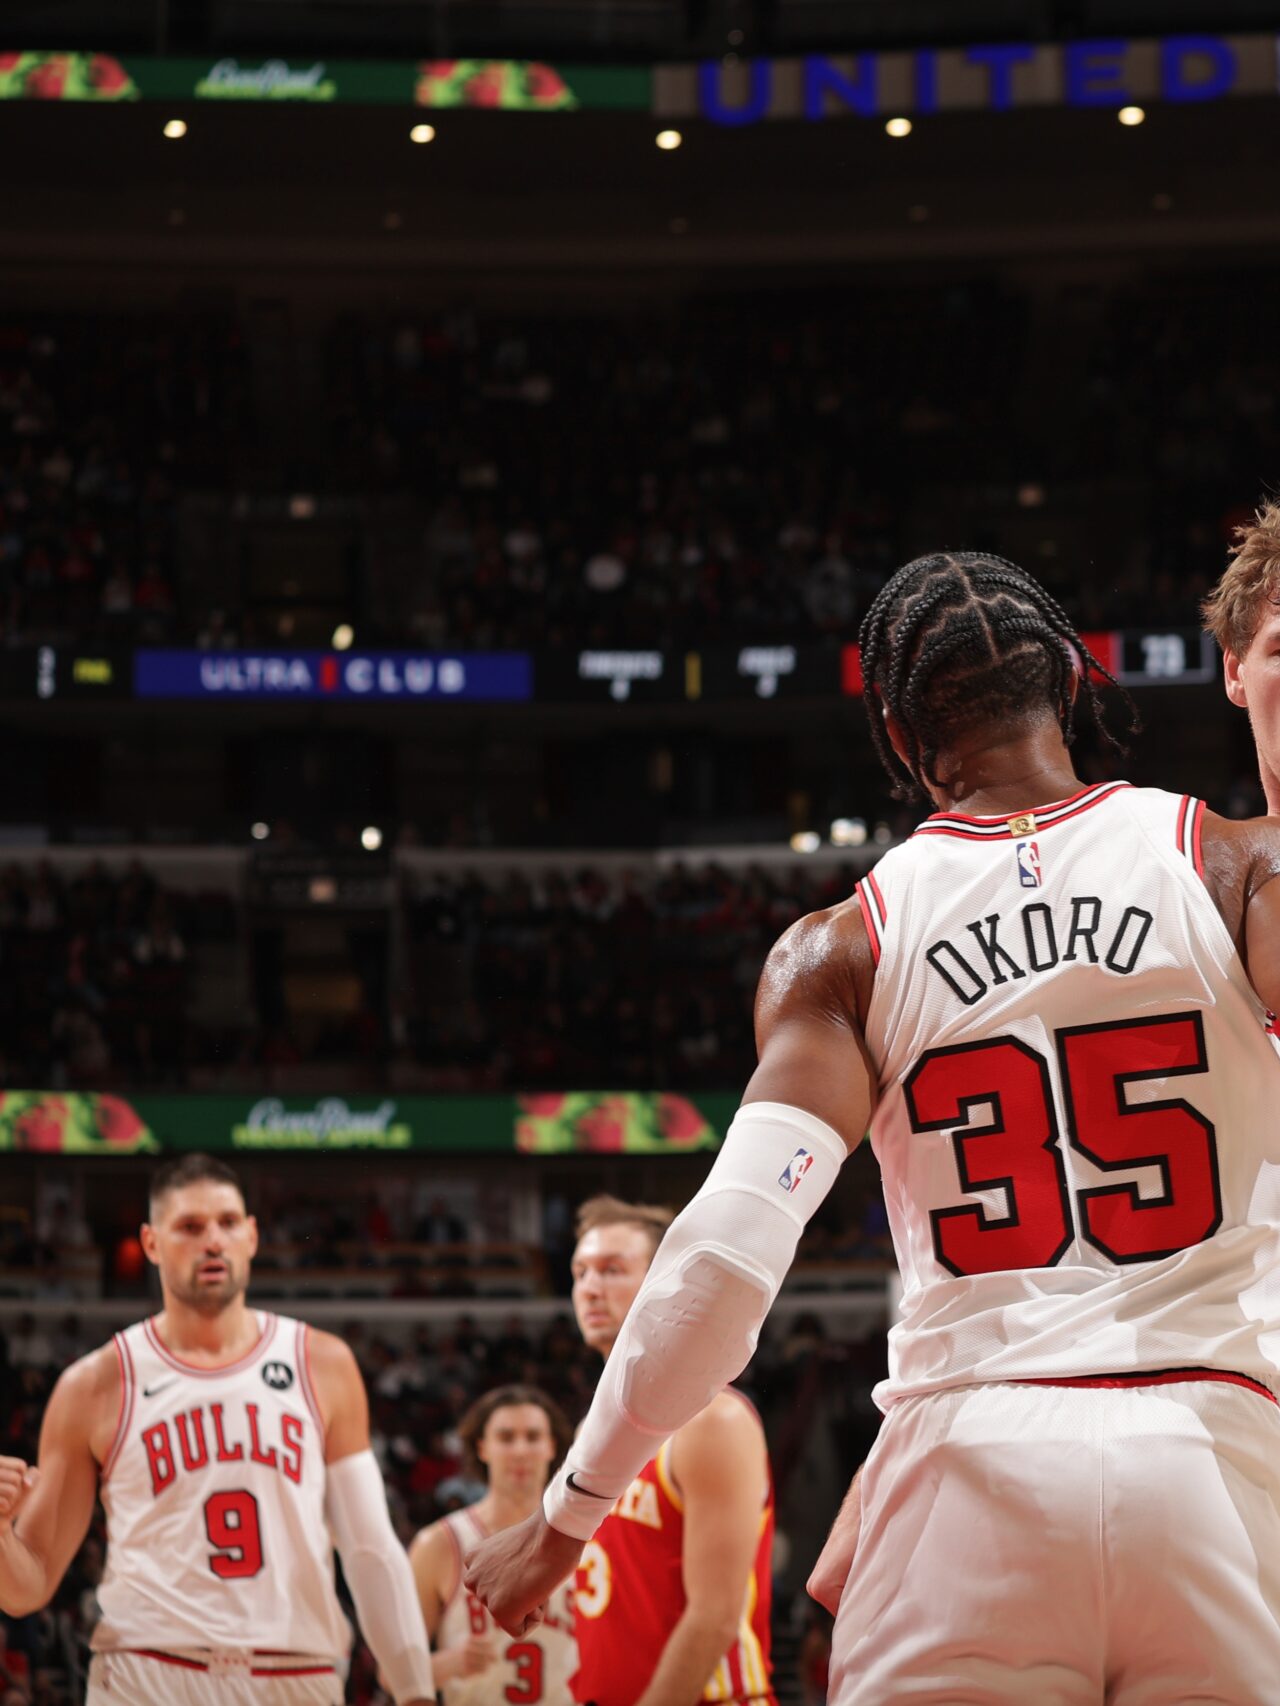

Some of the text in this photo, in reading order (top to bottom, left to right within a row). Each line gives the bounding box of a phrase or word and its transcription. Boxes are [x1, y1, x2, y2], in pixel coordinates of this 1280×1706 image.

[697, 33, 1237, 125] UNITED
[200, 656, 465, 694] ULTRA CLUB
[927, 896, 1153, 1005] OKORO
[903, 1010, 1222, 1277] 35
[141, 1403, 303, 1497] BULLS
[204, 1488, 264, 1579] 9
[505, 1642, 544, 1705] 3
